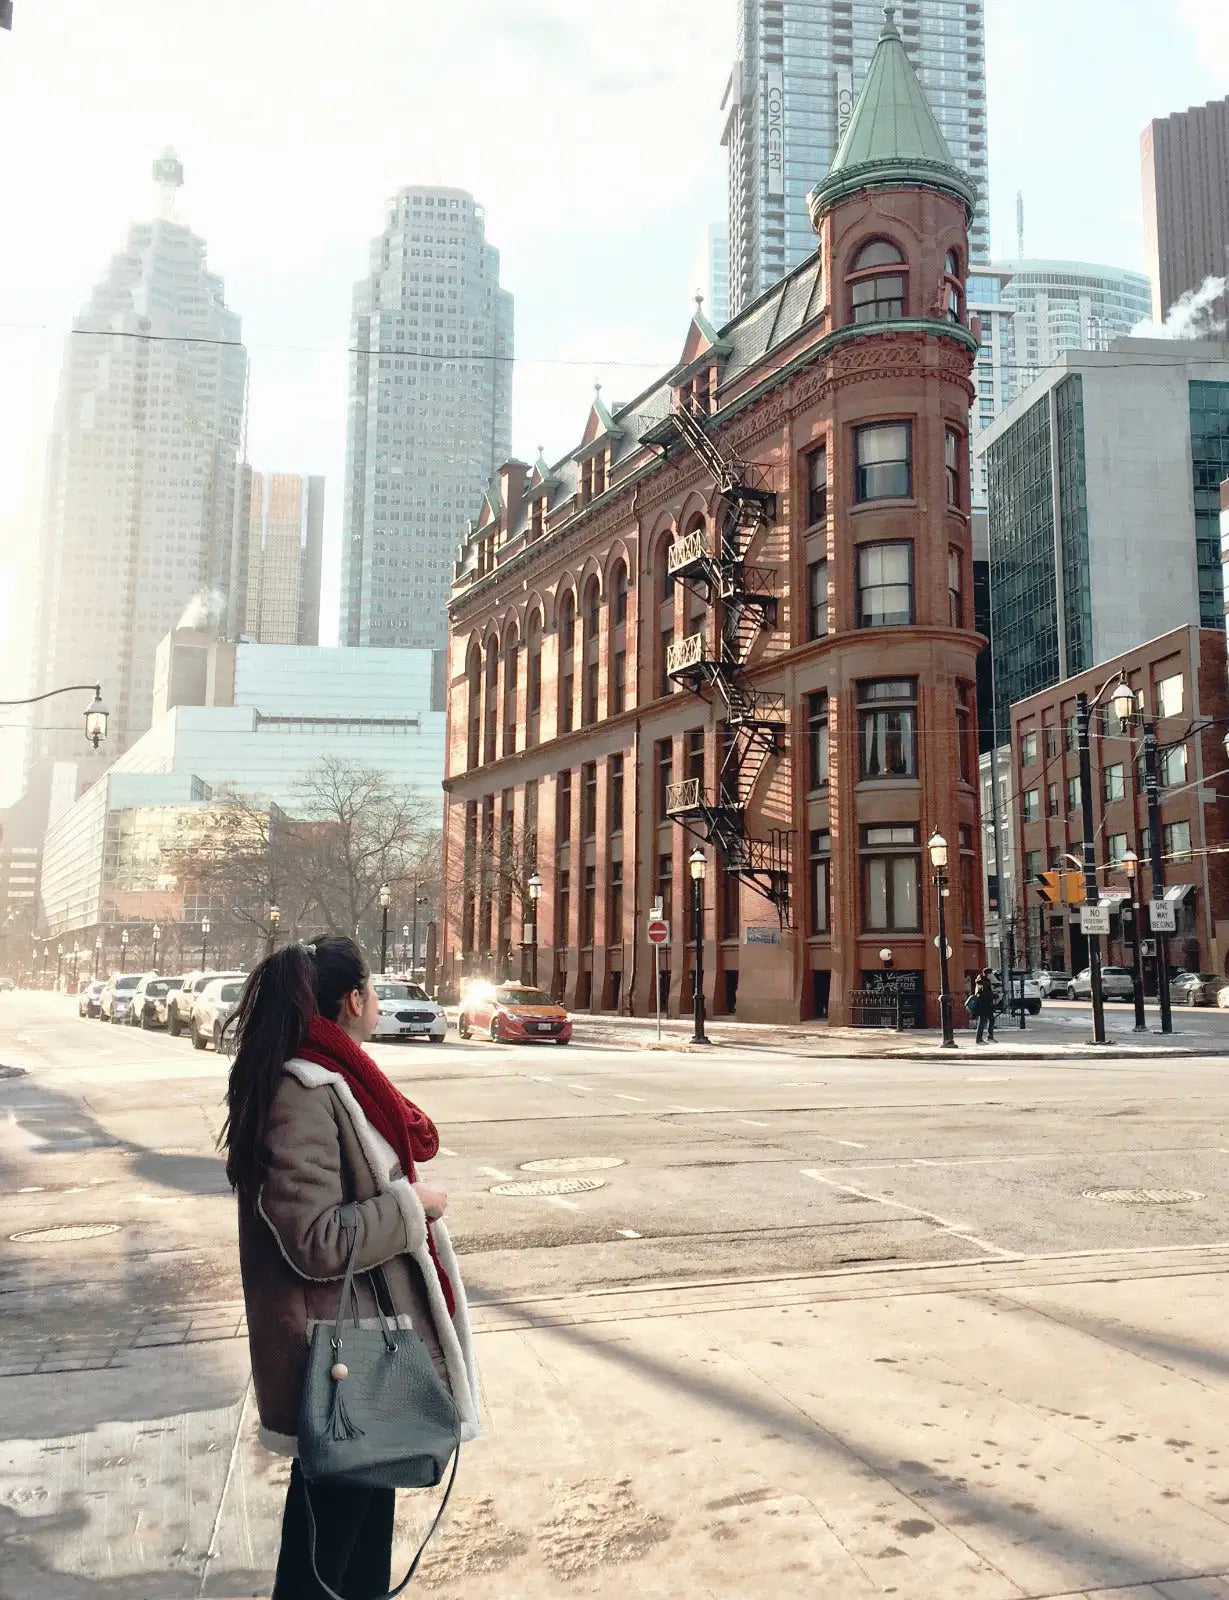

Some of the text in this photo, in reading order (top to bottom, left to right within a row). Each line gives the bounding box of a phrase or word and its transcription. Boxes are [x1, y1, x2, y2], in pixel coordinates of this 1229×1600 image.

[769, 87, 782, 173] CONCERT
[1155, 902, 1168, 910] ONE
[1090, 908, 1100, 917] NO
[1156, 911, 1168, 919] WAY
[1151, 920, 1175, 929] BEGINS
